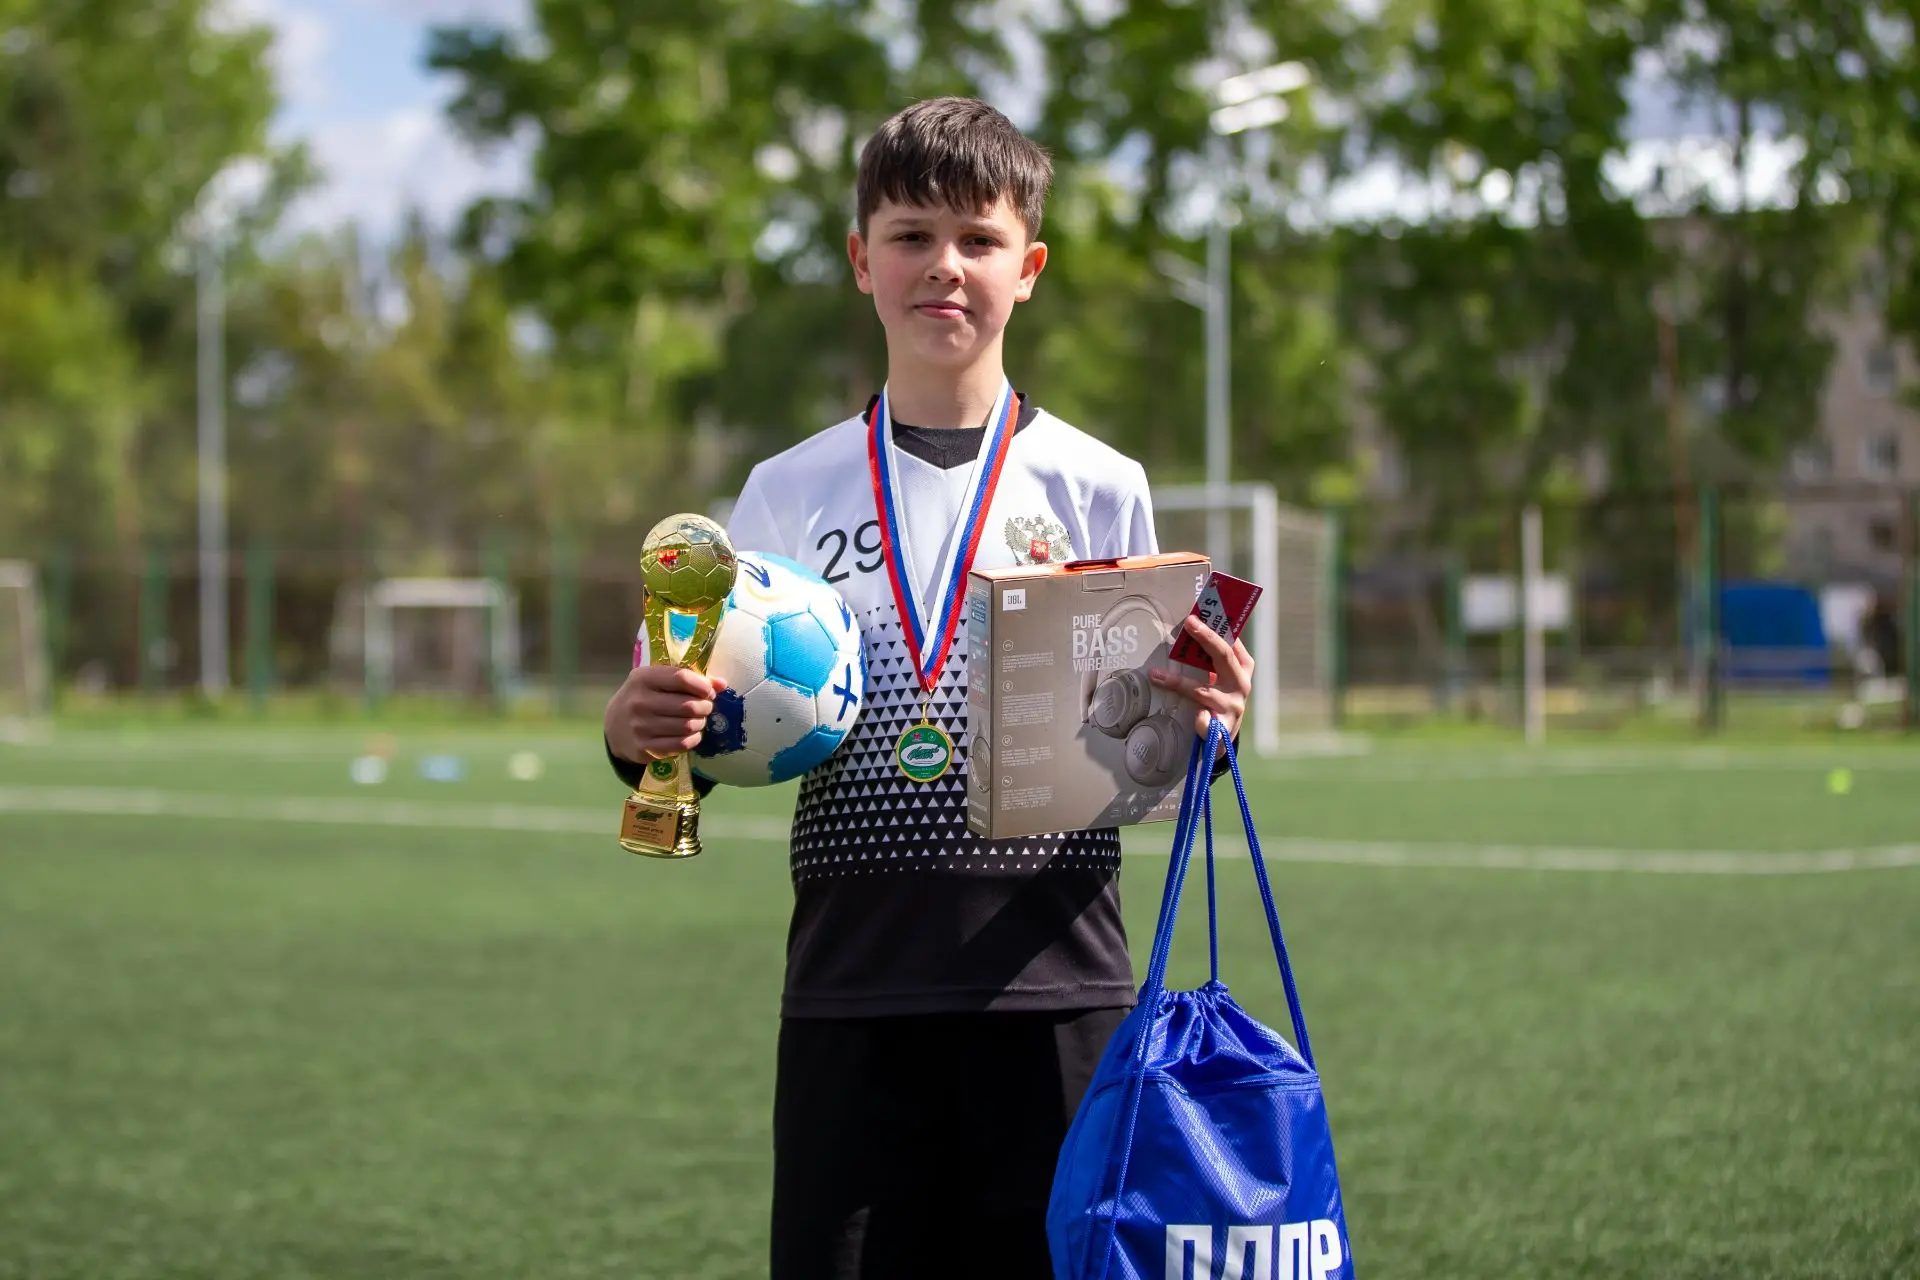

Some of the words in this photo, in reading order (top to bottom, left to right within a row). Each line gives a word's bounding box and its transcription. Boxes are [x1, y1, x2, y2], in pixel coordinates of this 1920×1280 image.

[817, 520, 885, 584] 29
[1072, 613, 1102, 630] PURE
[1072, 624, 1139, 659] BASS
[1072, 654, 1128, 674] WIRELESS
